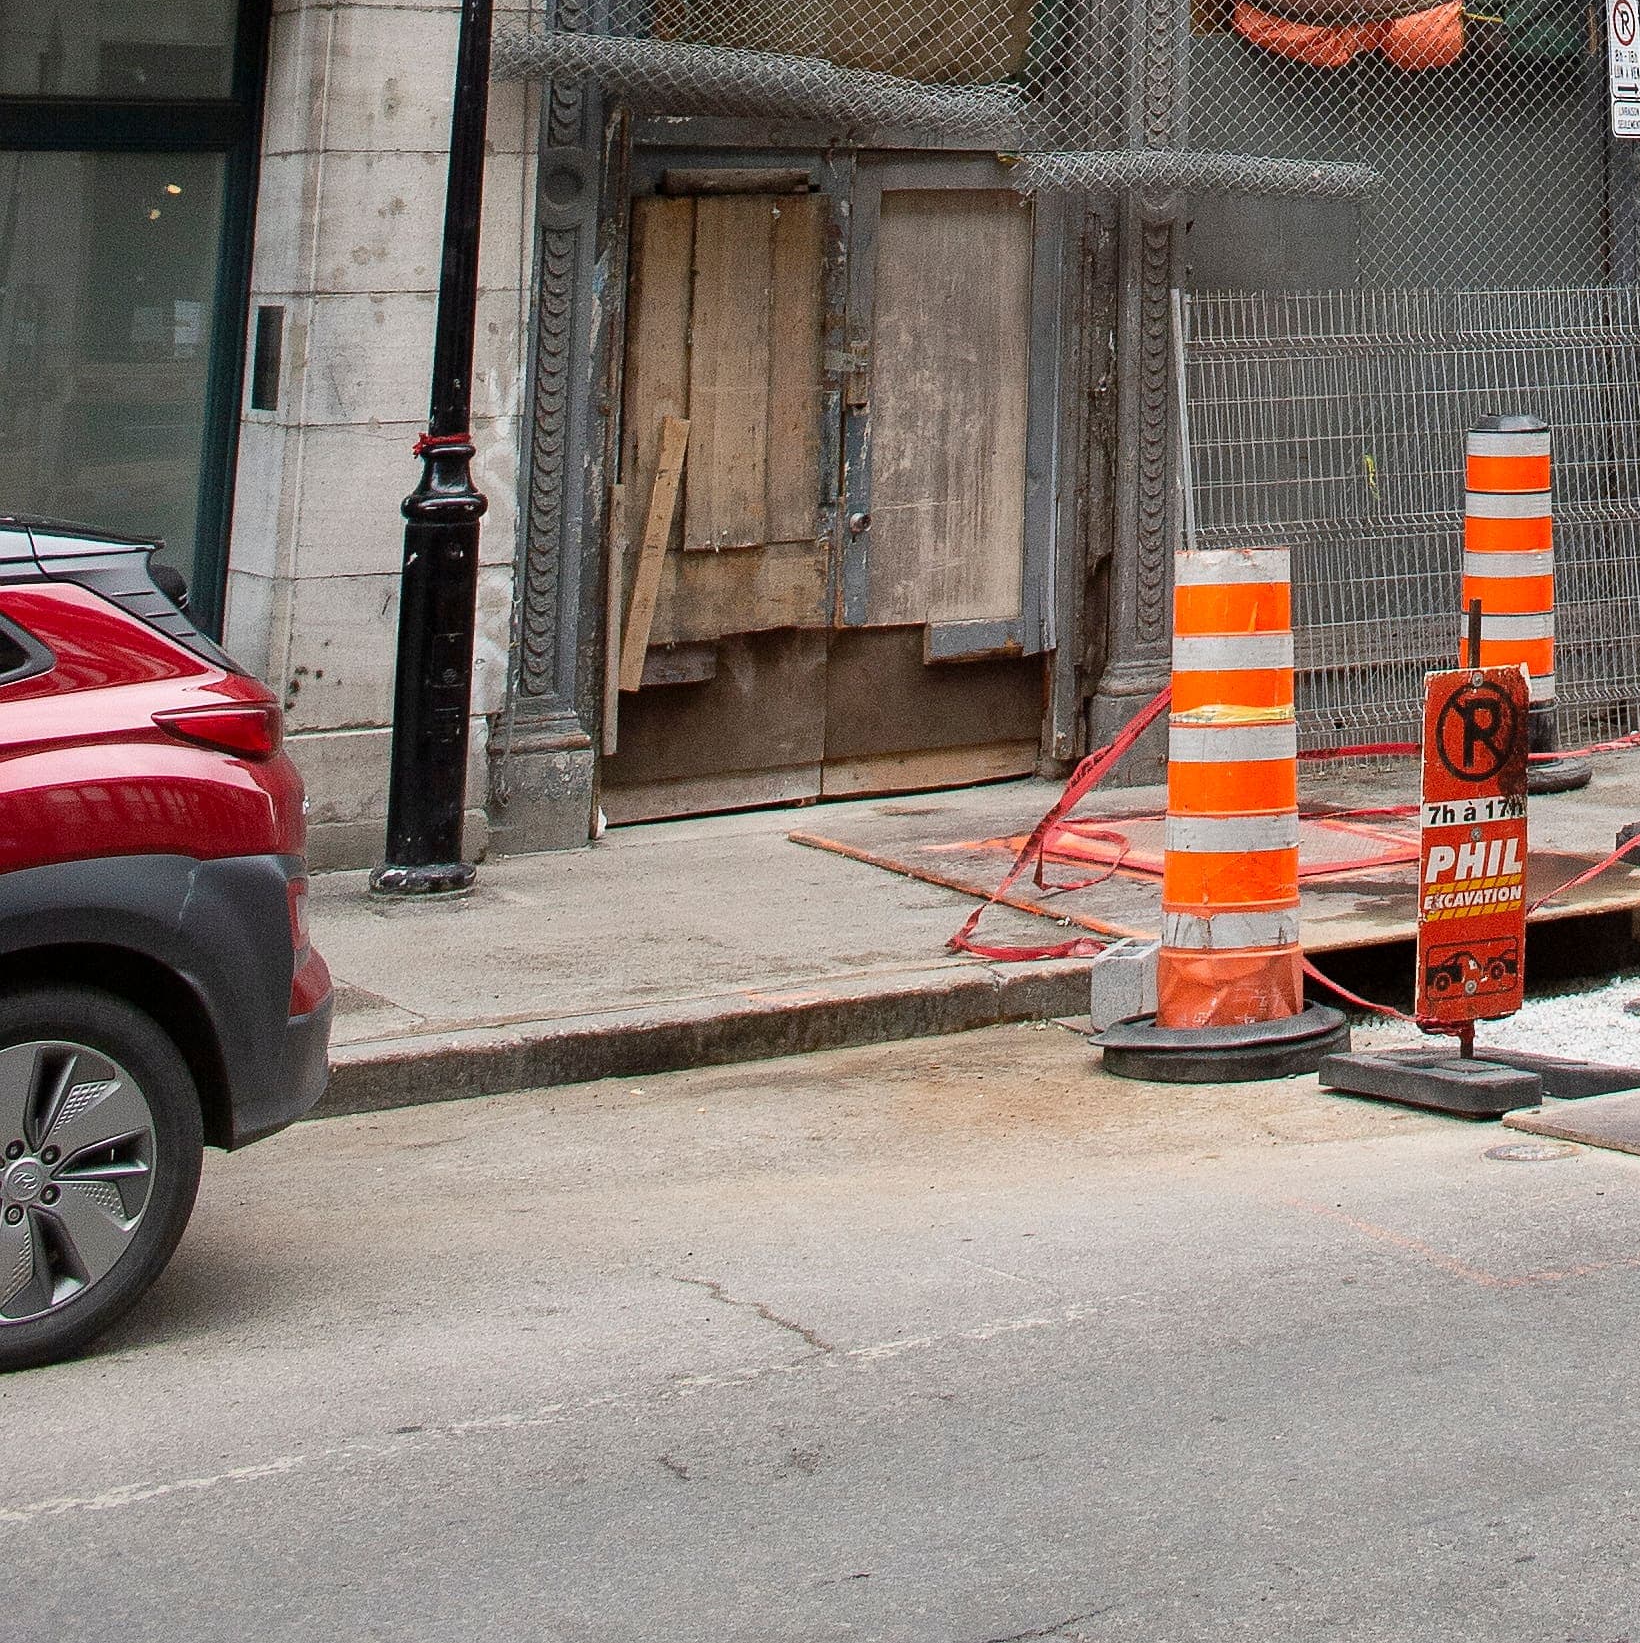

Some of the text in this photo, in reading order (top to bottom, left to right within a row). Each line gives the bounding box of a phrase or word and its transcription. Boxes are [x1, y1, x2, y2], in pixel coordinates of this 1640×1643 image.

[1428, 805, 1456, 826] 7h
[1463, 800, 1478, 822] à
[1425, 837, 1524, 884] PHIL
[1424, 886, 1523, 912] EXCAVATION
